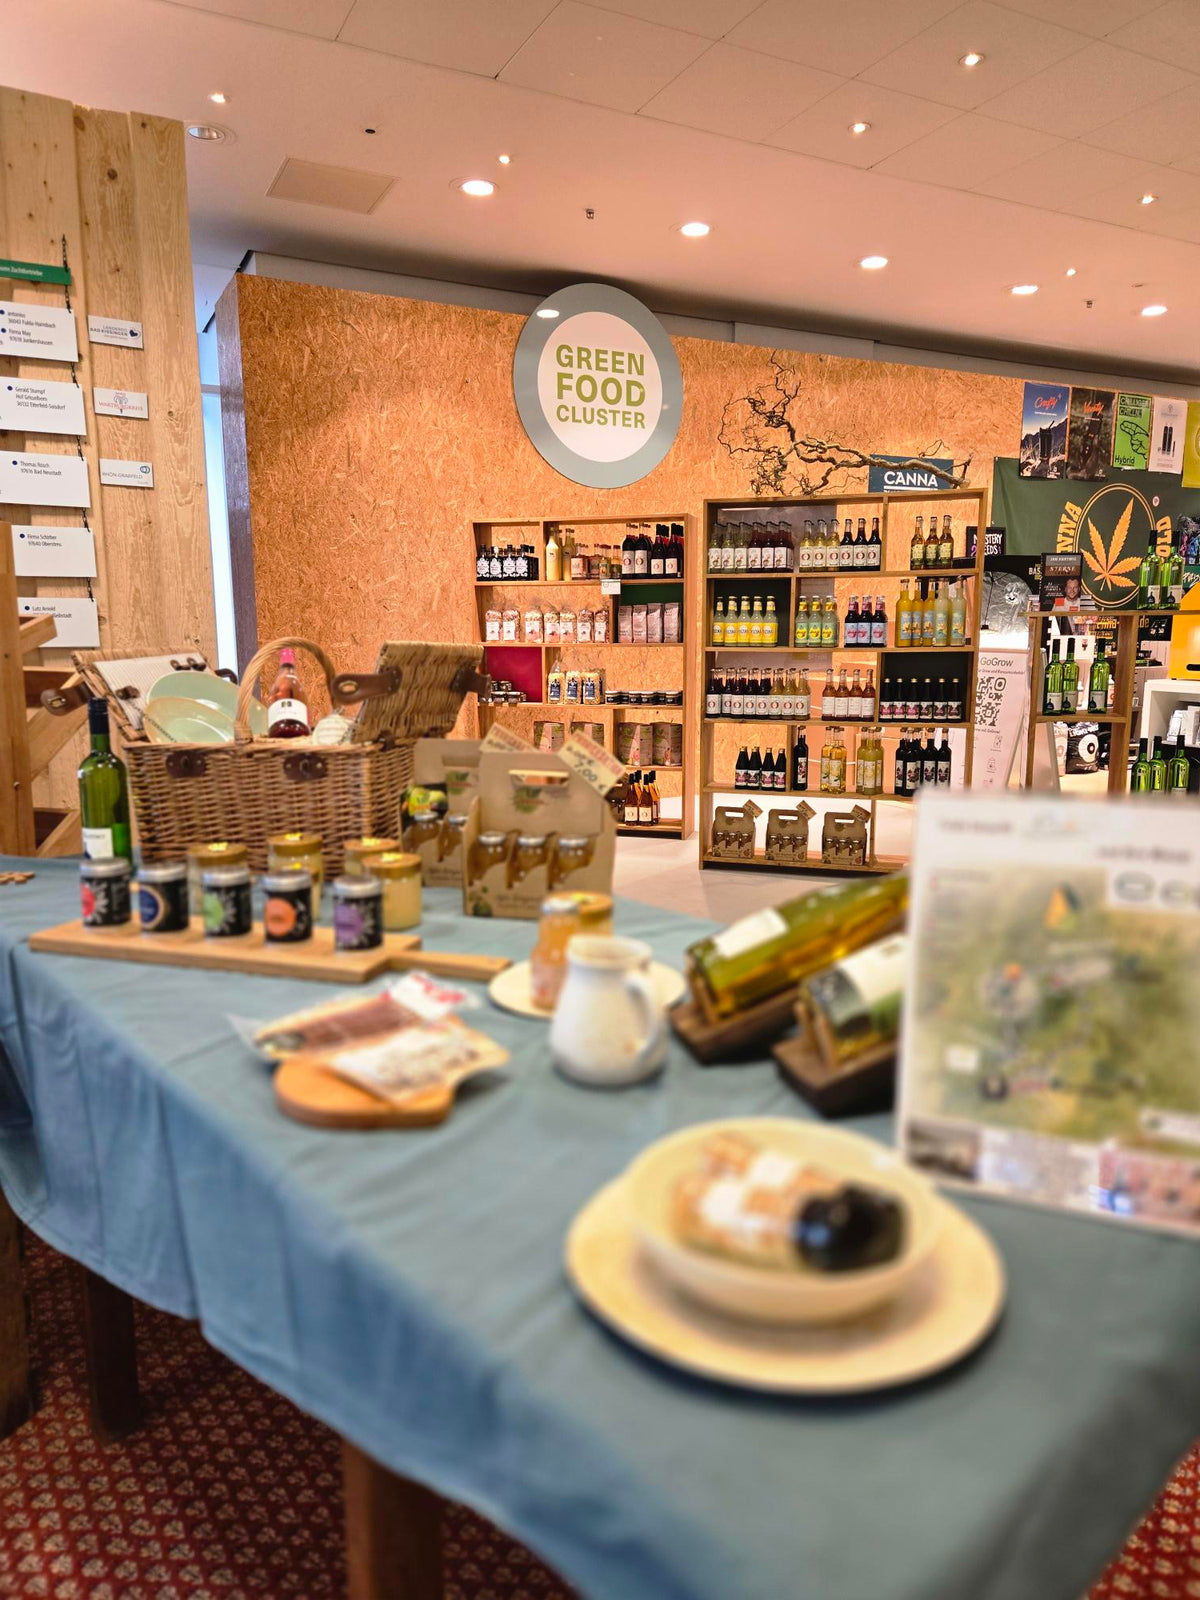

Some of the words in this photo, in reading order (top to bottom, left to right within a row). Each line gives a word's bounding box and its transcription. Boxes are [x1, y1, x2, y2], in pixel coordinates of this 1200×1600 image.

[556, 344, 644, 376] GREEN
[557, 372, 646, 407] FOOD
[556, 404, 645, 429] CLUSTER
[1114, 454, 1135, 466] Hybrid
[883, 471, 938, 487] CANNA
[1056, 501, 1082, 554] NNA
[1155, 516, 1172, 558] OLD
[973, 533, 1003, 545] MSTERY
[984, 544, 999, 556] EEDS
[980, 656, 1014, 667] GoGrow
